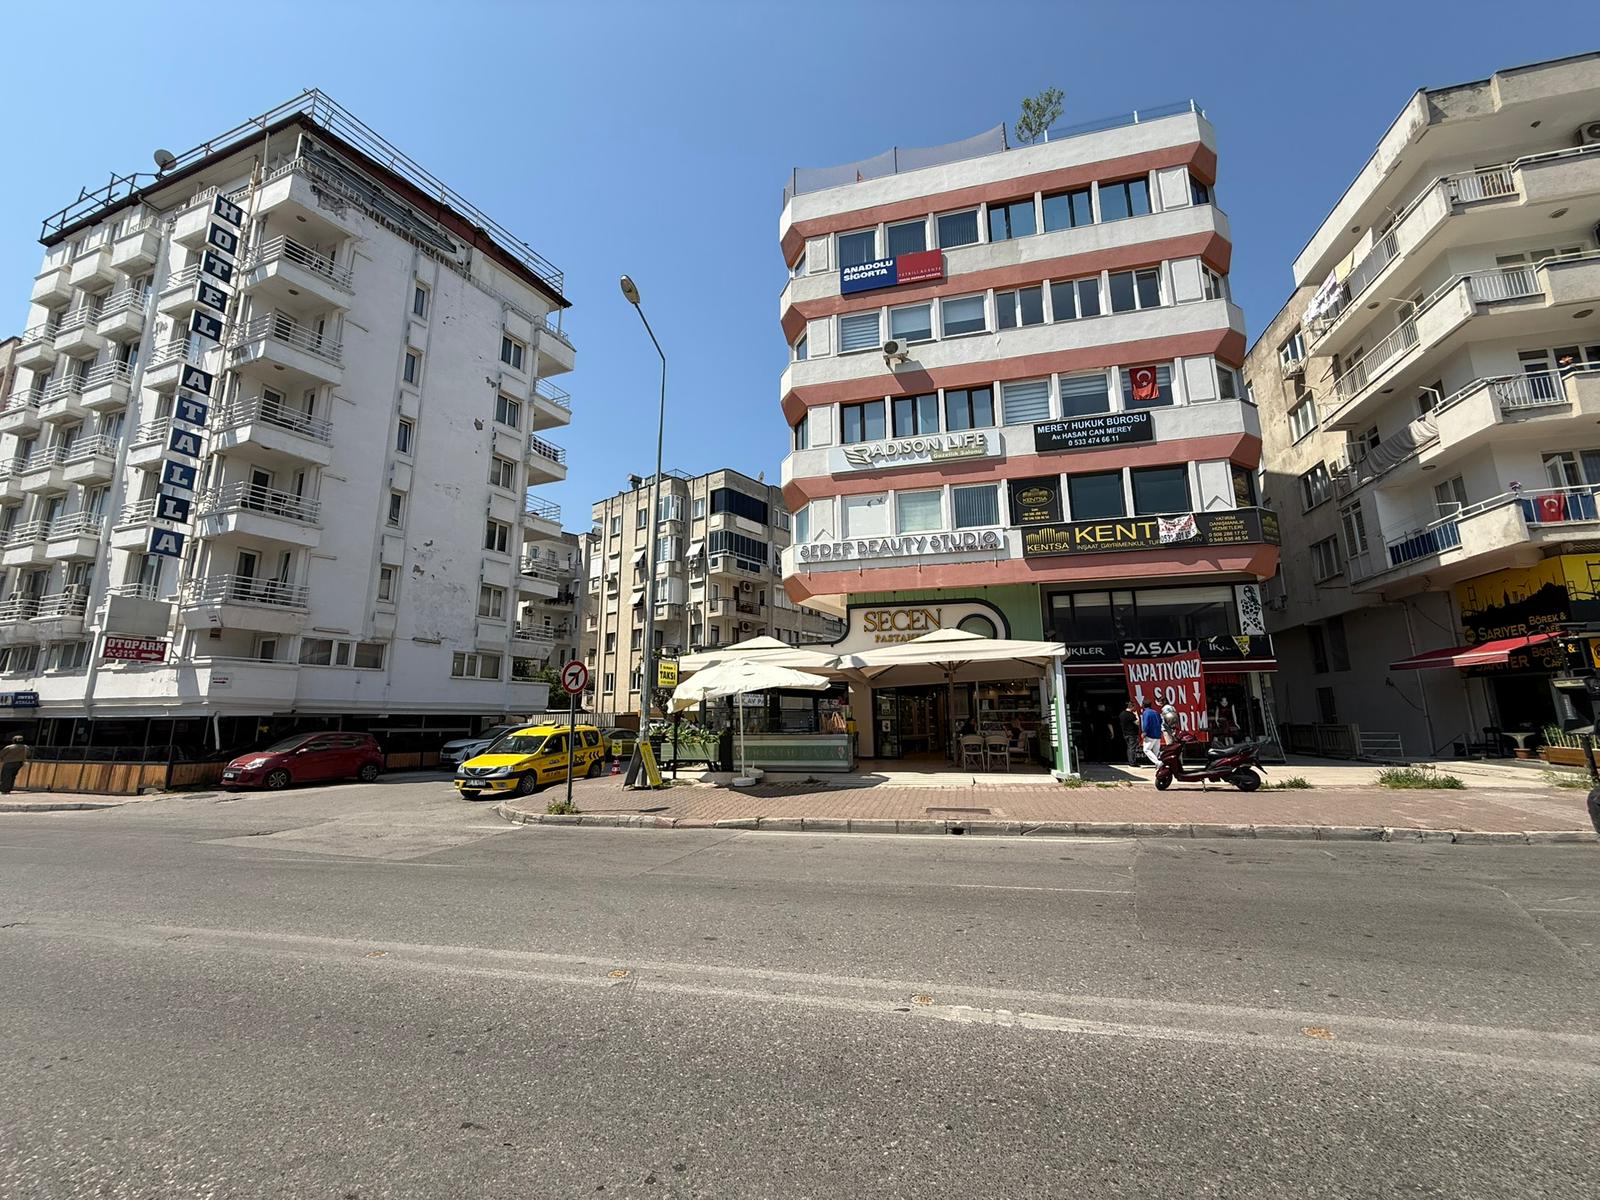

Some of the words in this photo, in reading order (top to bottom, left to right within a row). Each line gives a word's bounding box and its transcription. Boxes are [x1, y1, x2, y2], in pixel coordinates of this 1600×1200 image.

[198, 200, 241, 338] HOTEL
[843, 259, 893, 275] ANADOLU
[843, 268, 888, 282] SİGORTA
[1037, 423, 1069, 434] MEREY
[1071, 419, 1104, 430] HUKUK
[1106, 414, 1147, 426] BÜROSU
[1062, 431, 1087, 440] HASAN
[1089, 428, 1105, 437] CAN
[1106, 425, 1133, 434] MEREY
[947, 432, 985, 449] LIFE
[155, 370, 207, 553] ATALLA
[1074, 521, 1157, 544] KENT
[800, 542, 851, 559] SEDEF
[857, 536, 926, 555] BEAUTY
[929, 530, 997, 549] STUDIO
[1026, 541, 1070, 552] KENTSA
[1528, 613, 1559, 625] BÖREK
[1560, 611, 1567, 620] &
[1478, 623, 1528, 641] SARIYER
[106, 638, 164, 652] OTOPARK
[1123, 640, 1192, 658] PAŞALI
[659, 670, 676, 681] TAKSİ
[1127, 659, 1202, 683] KAPATIYORUZ
[1154, 684, 1187, 707] SON
